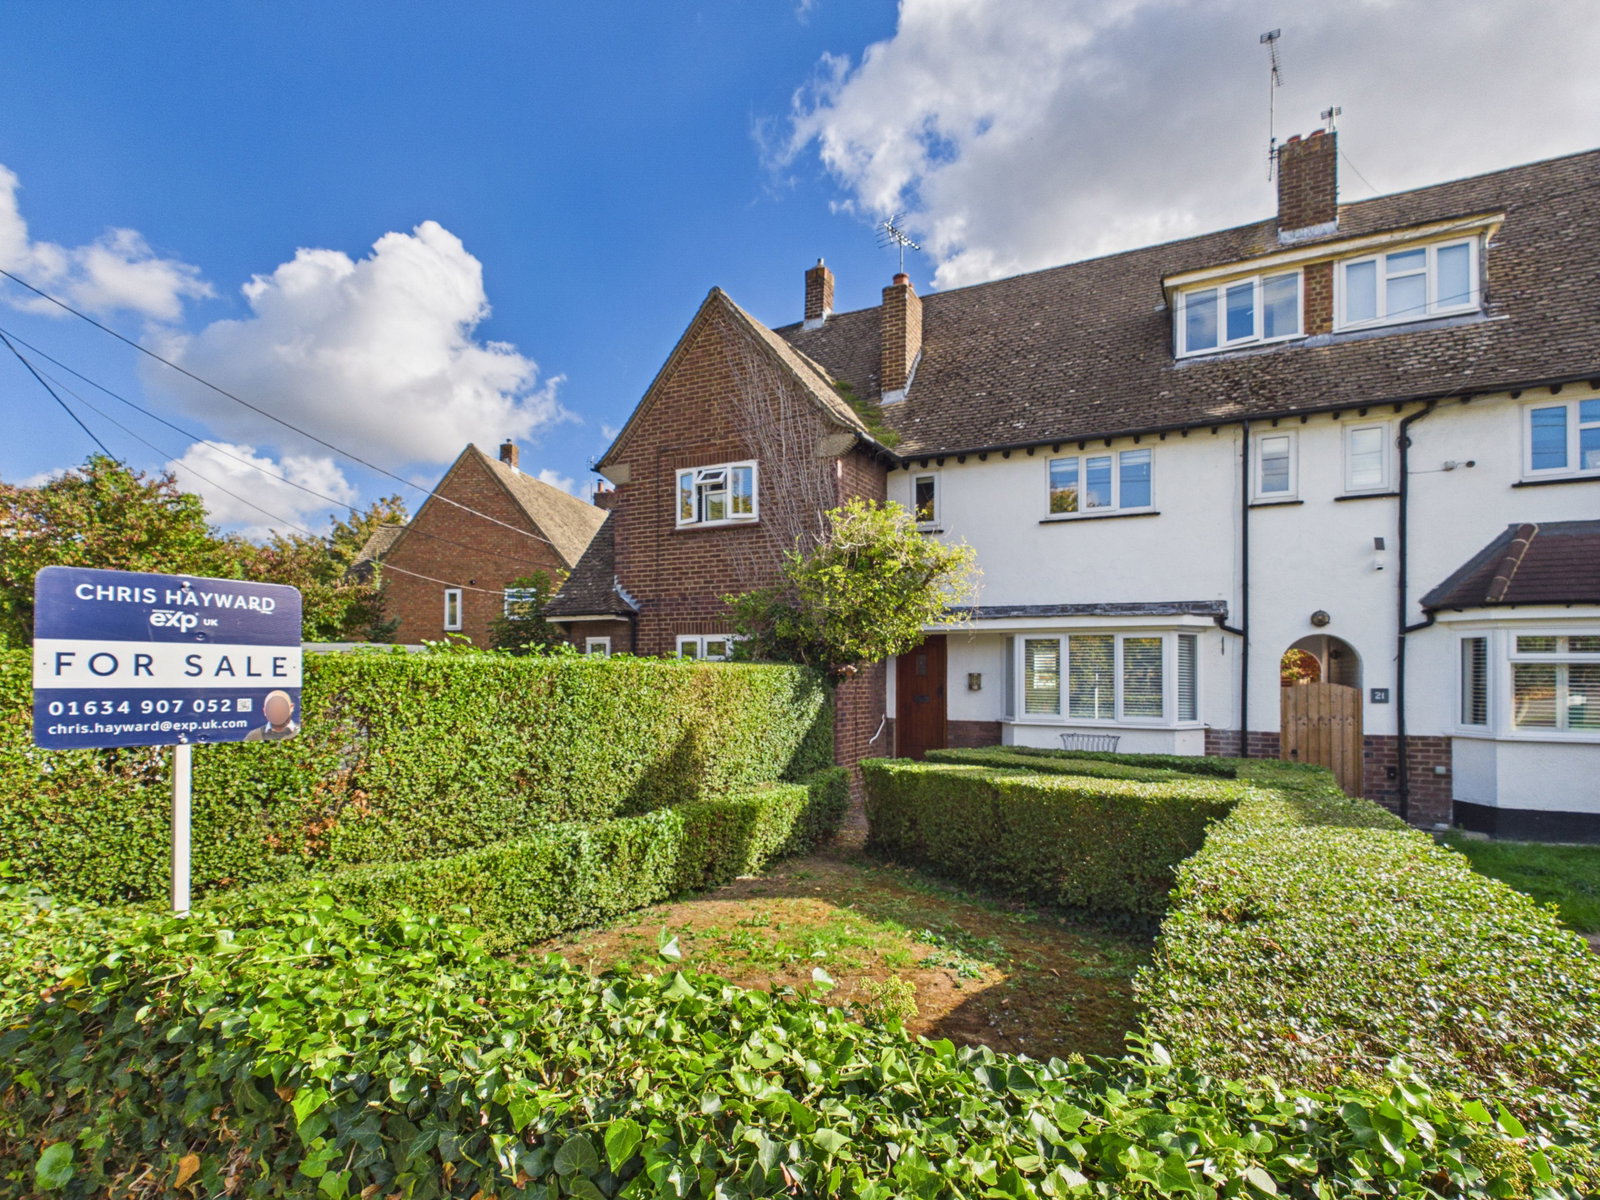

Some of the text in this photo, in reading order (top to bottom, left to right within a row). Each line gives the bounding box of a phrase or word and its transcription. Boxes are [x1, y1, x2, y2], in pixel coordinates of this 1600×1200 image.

[75, 583, 276, 612] CHRIS HAYWARD
[203, 618, 219, 627] UK
[54, 652, 288, 677] FOR SALE
[1374, 691, 1385, 700] 21
[48, 699, 231, 716] 01634 907 052
[48, 719, 248, 735] chris.hayward@exp.uk.com
